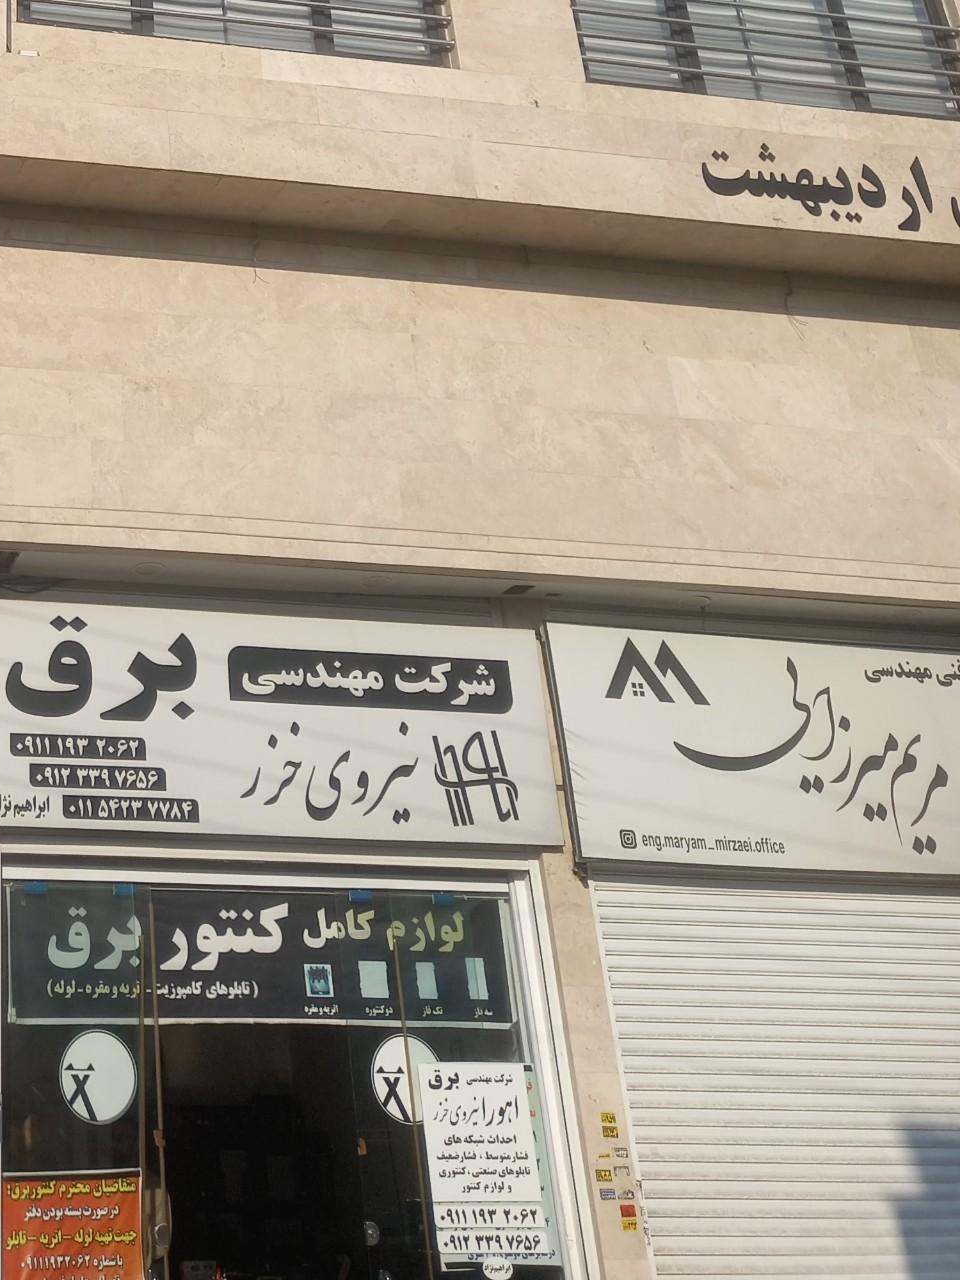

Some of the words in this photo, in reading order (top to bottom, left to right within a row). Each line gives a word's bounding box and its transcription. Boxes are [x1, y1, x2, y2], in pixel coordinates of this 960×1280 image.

[702, 142, 933, 232] اردیبهشت
[5, 614, 198, 721] برق
[864, 661, 933, 684] مهندسی
[242, 660, 384, 697] مهندسی
[395, 662, 496, 706] شرکت
[16, 736, 50, 755] ۰۹۱۱
[57, 737, 89, 756] ۱۹۳
[96, 738, 139, 758] ۲۰۶۲
[239, 721, 303, 806] خزر
[304, 721, 419, 825] نیروی
[36, 766, 71, 787] ۰۹۱۲
[76, 767, 111, 788] ۳۳۹
[115, 769, 159, 789] ۷۶۵۶
[890, 733, 949, 854] مریم
[13, 795, 50, 819] ابراهیم
[68, 797, 93, 817] ۰۱۱
[98, 798, 143, 819] ۵۴۲۳
[147, 800, 193, 820] ۷۷۸۴
[642, 830, 786, 855] eng.maryam_mirzaei.office
[47, 906, 143, 969] برق
[159, 902, 289, 970] کنتور
[302, 907, 375, 949] کامل
[386, 911, 464, 952] لوازم
[85, 980, 110, 999] مقره
[156, 981, 202, 999] کامپوزیت
[428, 1069, 460, 1091] برق
[466, 1075, 493, 1085] مهندسی
[494, 1074, 513, 1087] شرکت
[449, 1096, 480, 1127] نیروی
[487, 1134, 517, 1145] احداث
[438, 1166, 466, 1178] کنتوری
[498, 1166, 531, 1178] تابلوهای
[59, 1181, 90, 1198] محترم
[93, 1178, 136, 1196] متقاضیان
[461, 1181, 481, 1193] کنتور
[484, 1181, 505, 1193] لوازم
[24, 1204, 42, 1221] دفتر
[43, 1206, 64, 1220] بودن
[64, 1206, 82, 1218] بسته
[83, 1205, 109, 1219] صورت
[109, 1204, 119, 1218] در
[440, 1208, 468, 1225] ۰۹۱۱
[472, 1208, 497, 1225] ۱۹۳
[503, 1208, 538, 1225] ۲۰۶۲
[6, 1230, 27, 1250] تابلو
[74, 1228, 93, 1246] لوله
[95, 1228, 113, 1245] تهیه
[114, 1230, 137, 1246] جهت
[443, 1234, 470, 1251] ۰۹۱۲
[475, 1234, 503, 1251] ۳۳۹
[505, 1234, 542, 1251] ۷۶۵۶
